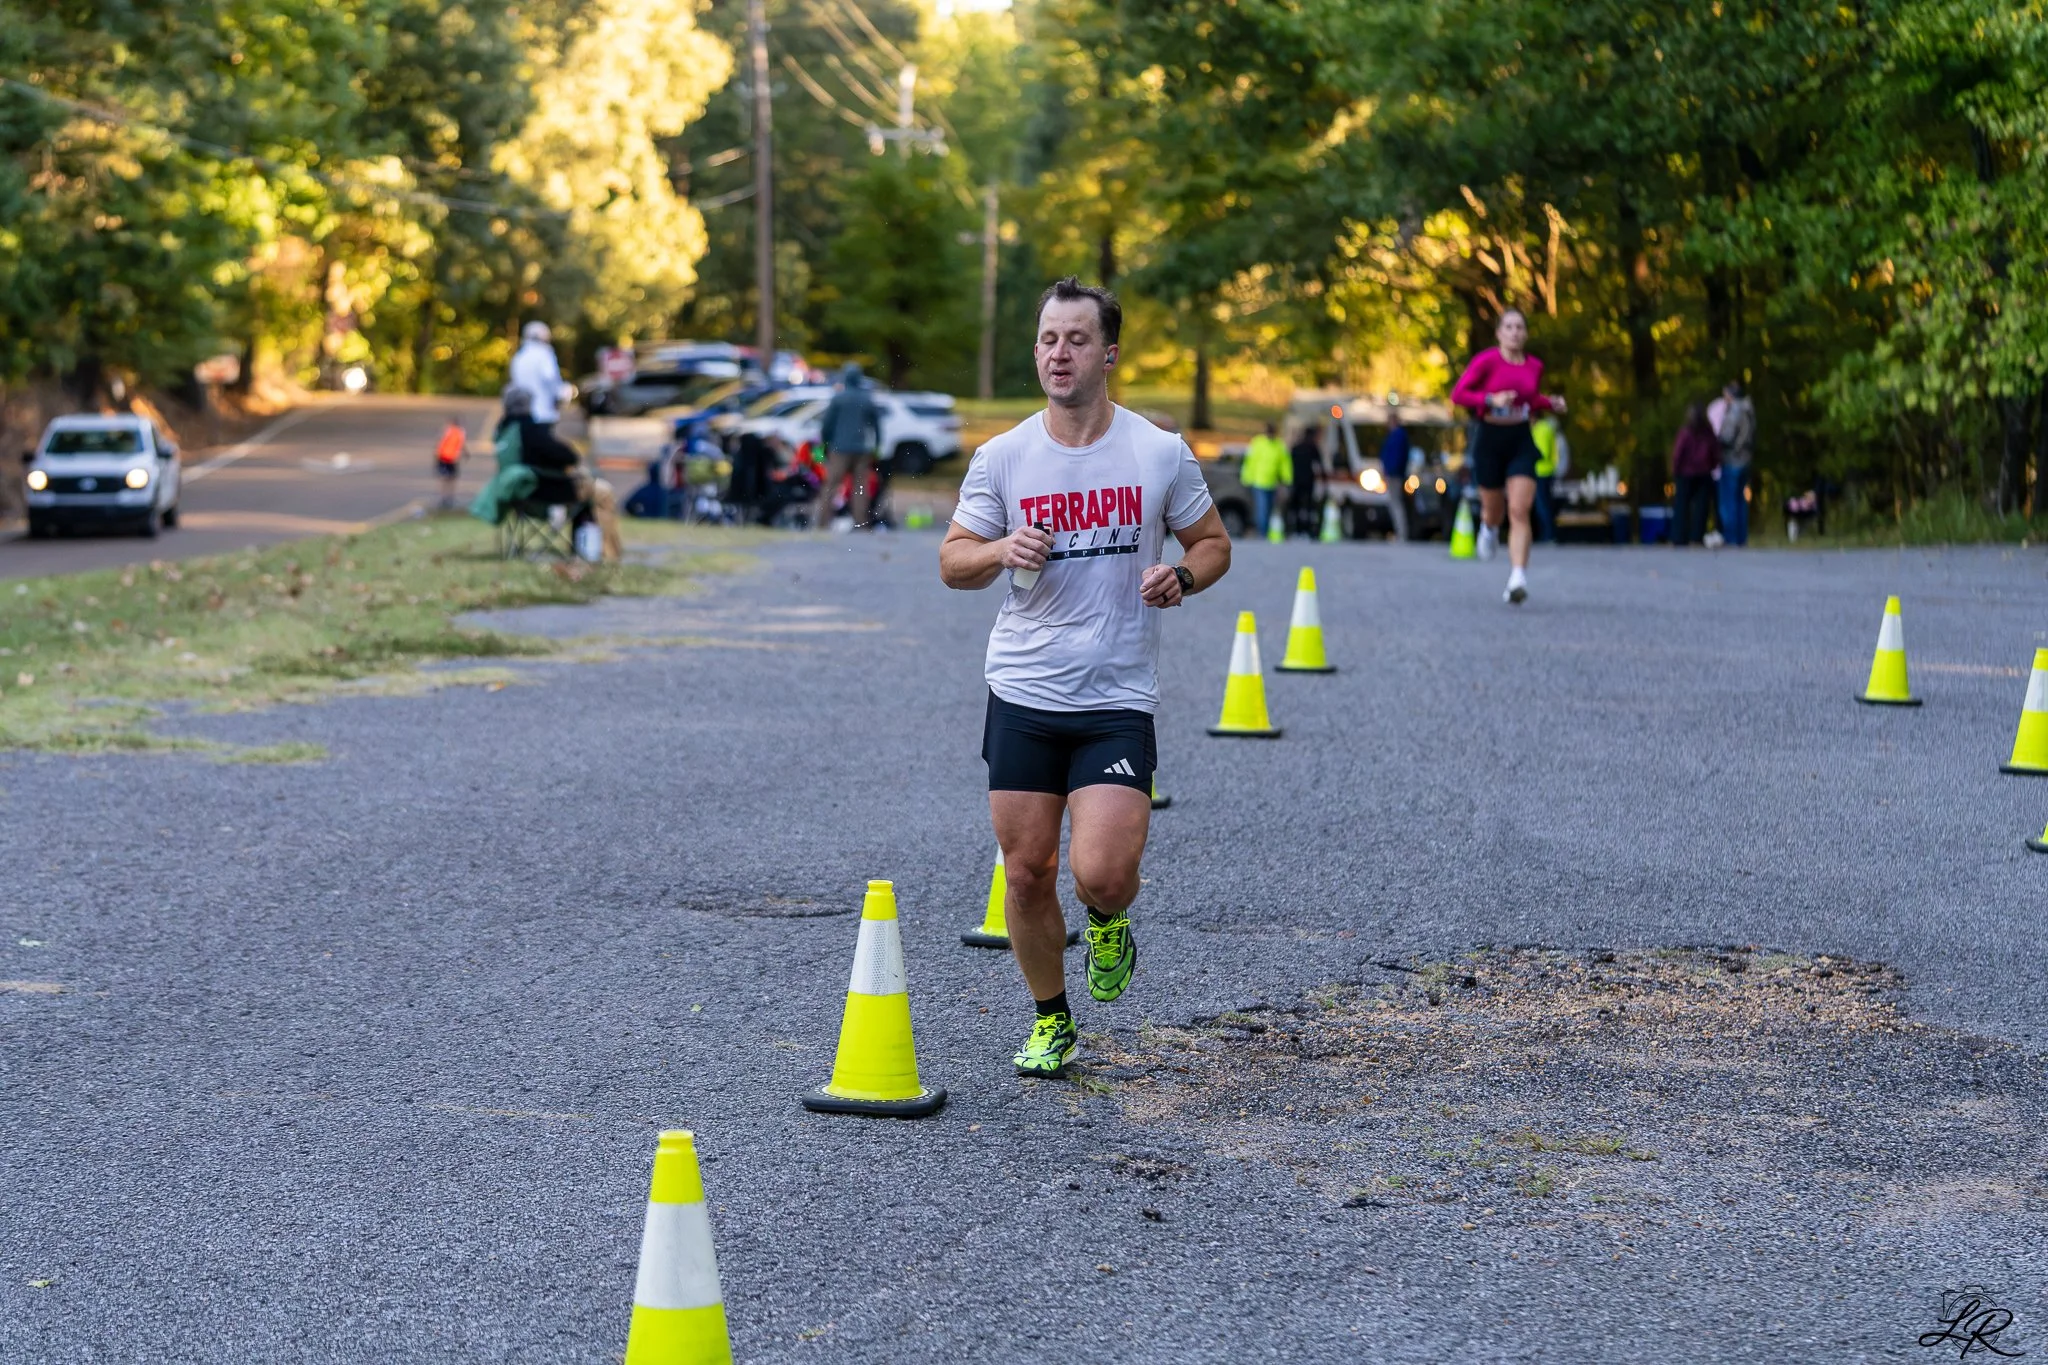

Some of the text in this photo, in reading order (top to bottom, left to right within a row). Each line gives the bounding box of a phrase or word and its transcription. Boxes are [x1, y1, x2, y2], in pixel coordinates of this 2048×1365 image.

[1020, 485, 1142, 532] TERRAPIN
[1050, 527, 1142, 550] CING
[1049, 547, 1135, 560] EMPHIS
